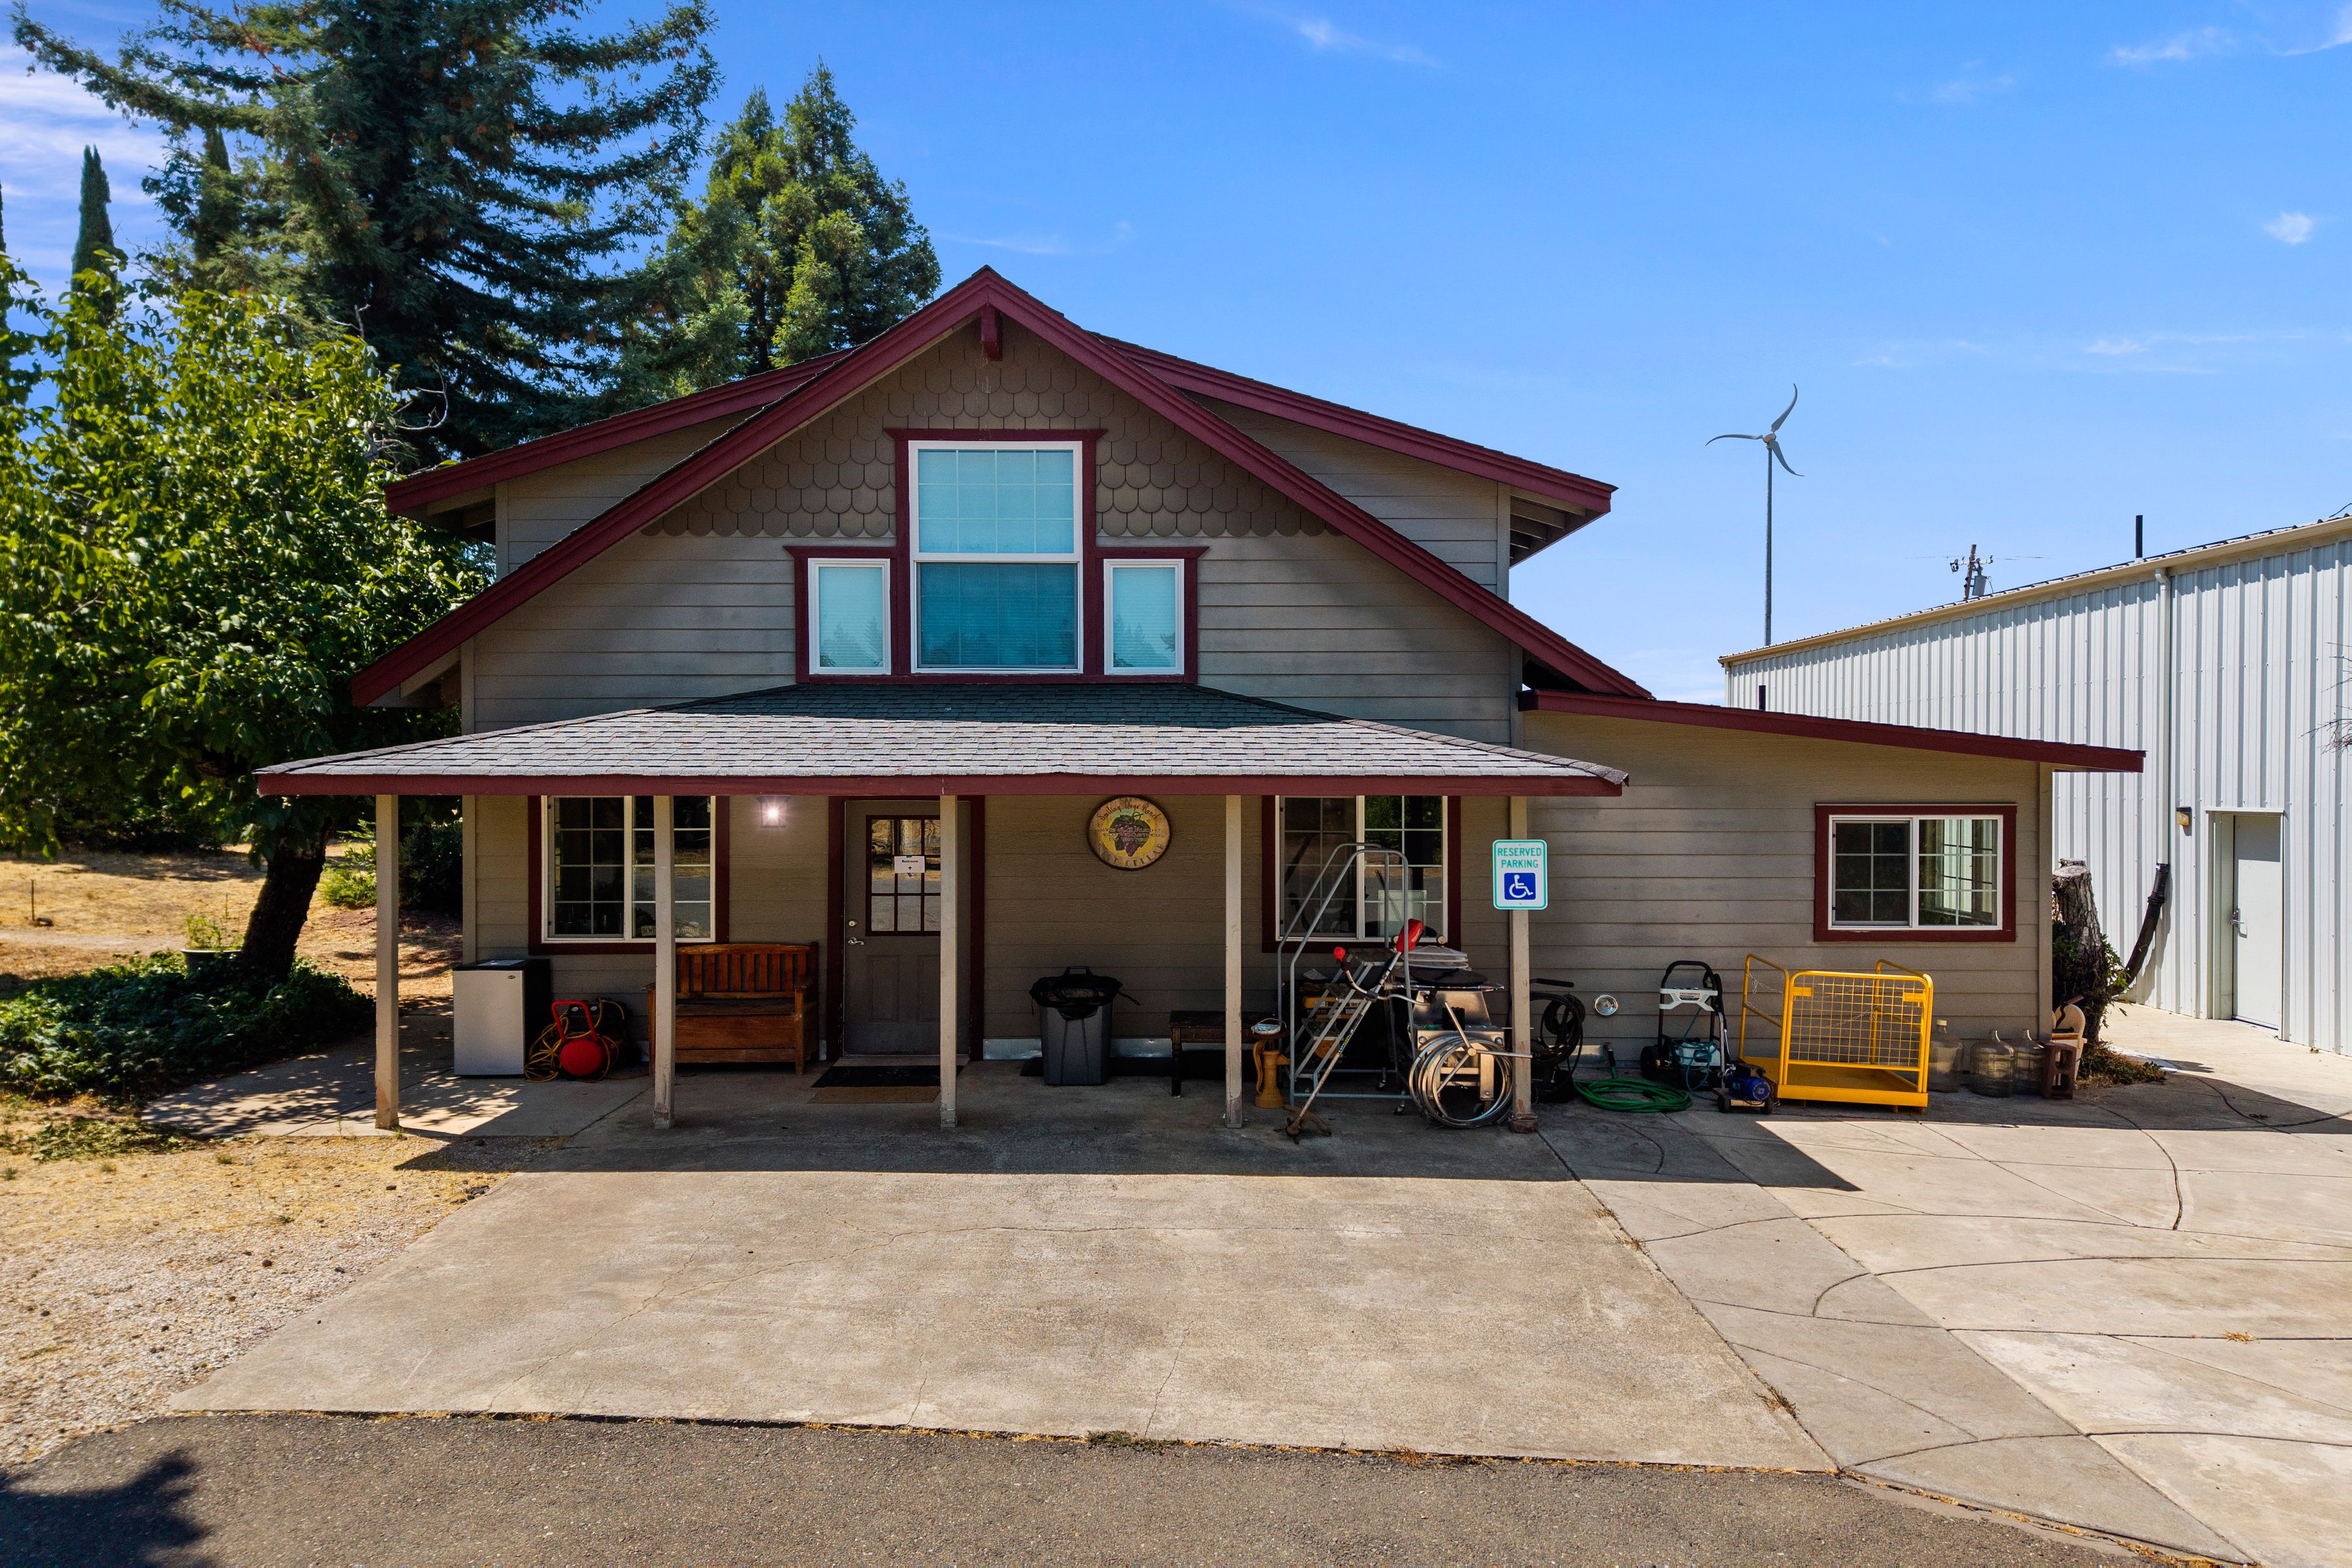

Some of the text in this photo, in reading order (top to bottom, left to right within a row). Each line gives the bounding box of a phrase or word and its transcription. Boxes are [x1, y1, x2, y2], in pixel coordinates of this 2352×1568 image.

[1097, 806, 1122, 821] Smiling
[1497, 847, 1542, 857] RESERVED
[1501, 859, 1539, 868] PARKING
